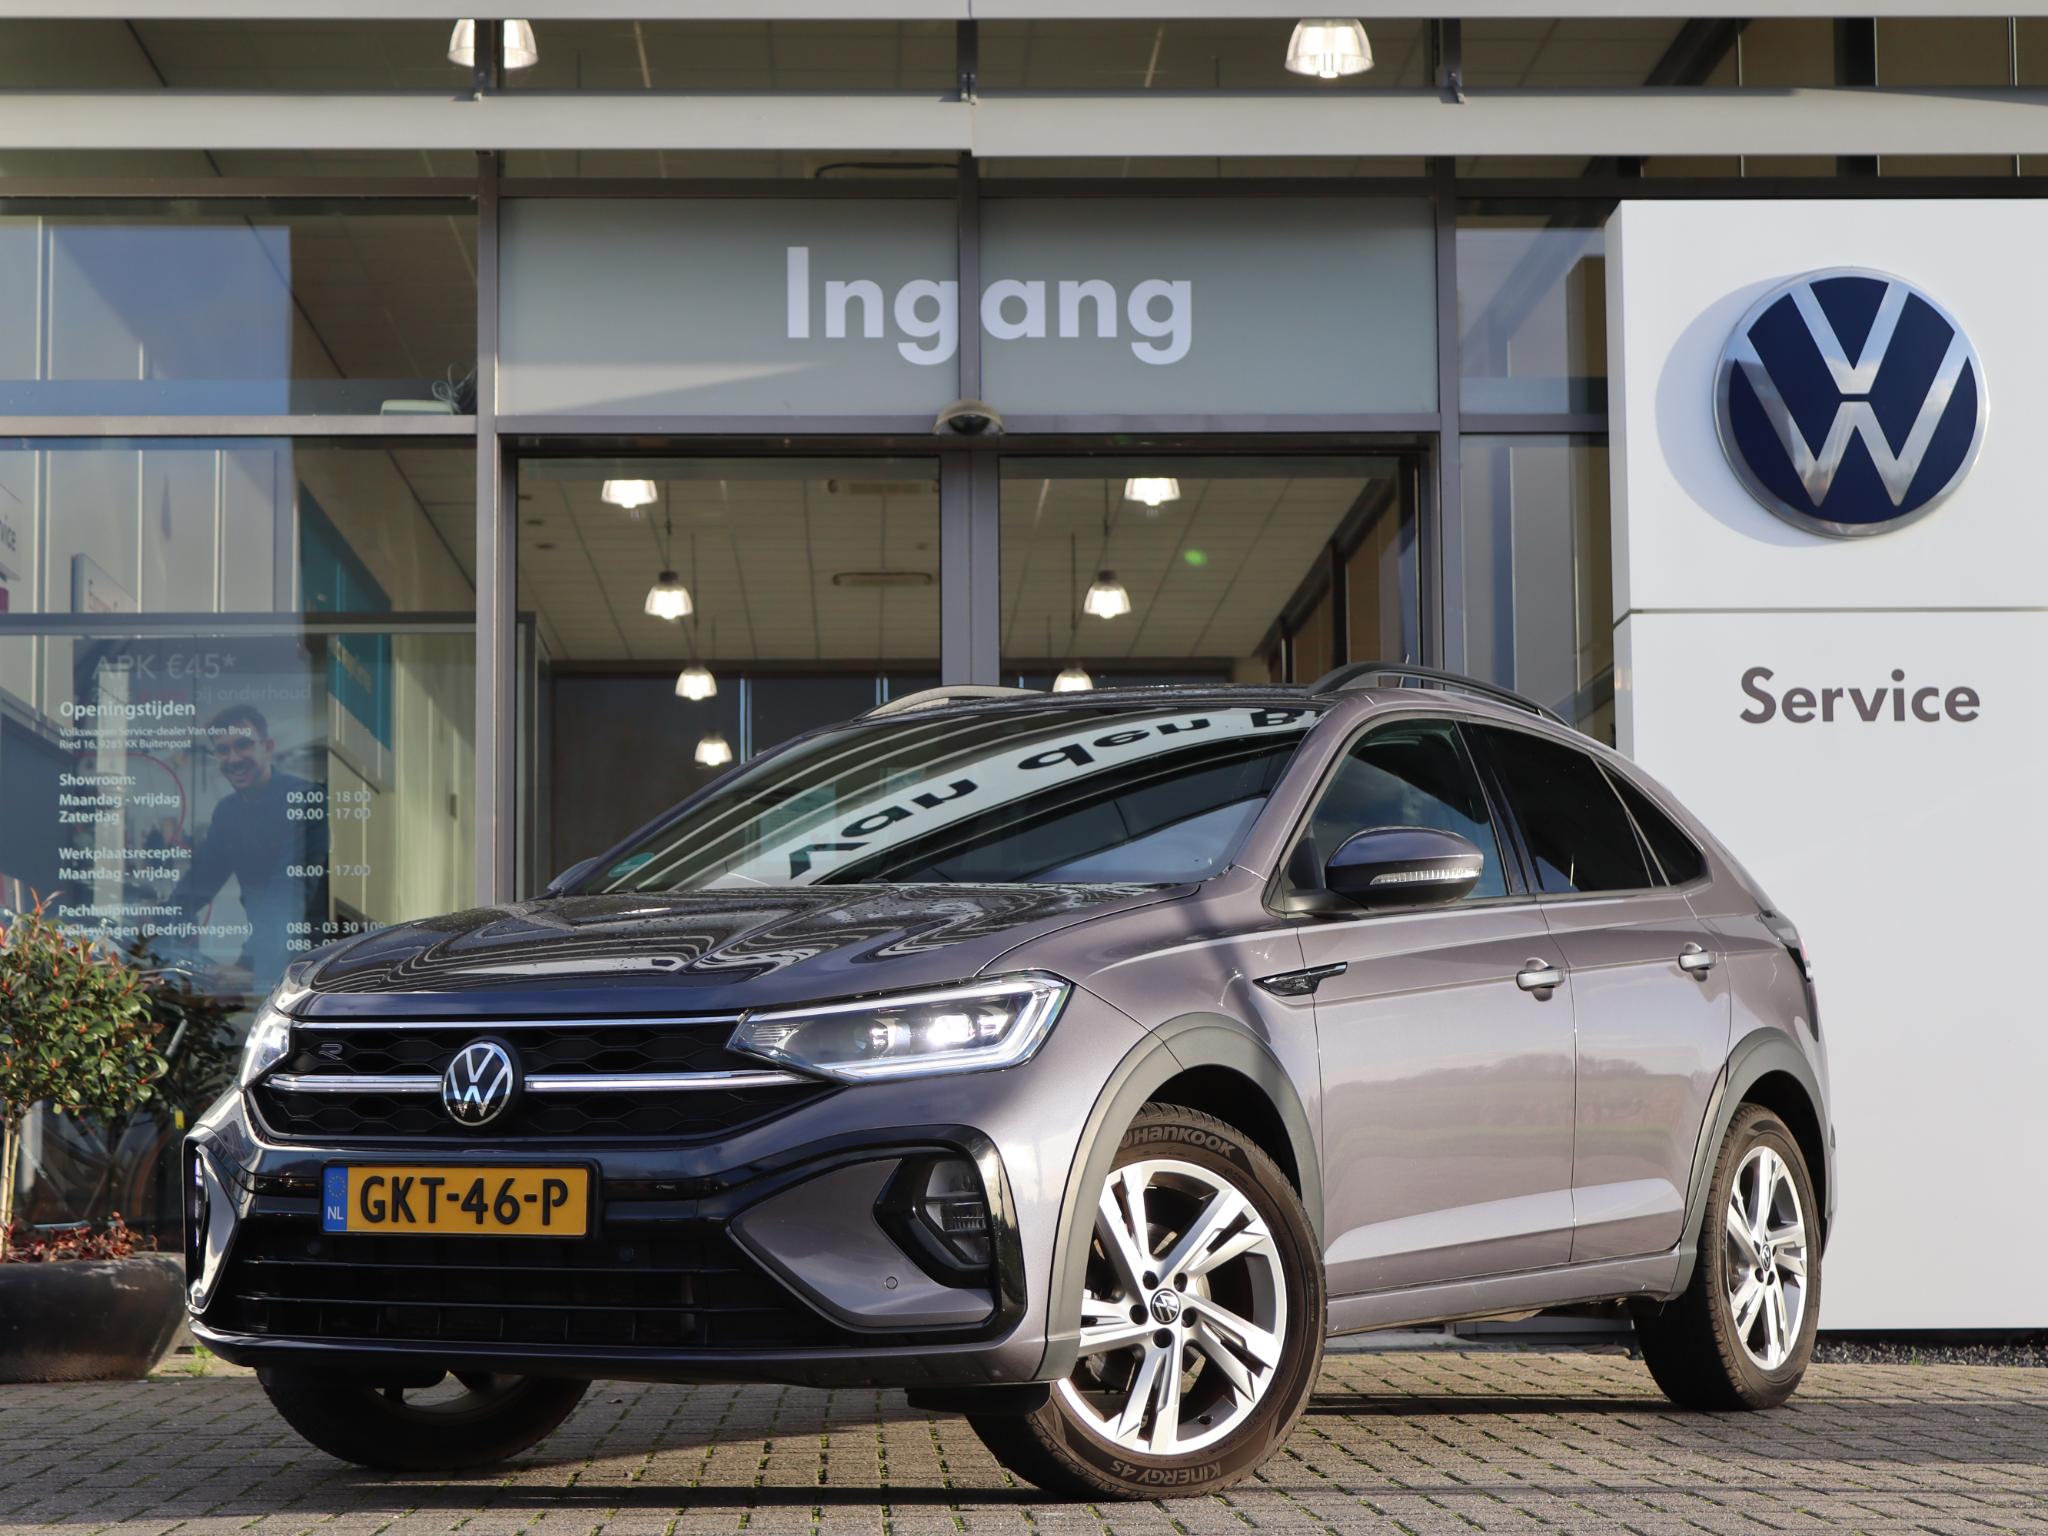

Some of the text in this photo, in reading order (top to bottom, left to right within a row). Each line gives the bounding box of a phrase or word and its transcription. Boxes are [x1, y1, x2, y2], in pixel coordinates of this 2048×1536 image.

[787, 246, 1192, 365] Ingang
[93, 654, 156, 680] APK
[1739, 666, 1981, 724] Service
[59, 701, 197, 720] Openingstijden
[117, 726, 187, 736] Service-dealer
[188, 726, 206, 736] Van
[207, 726, 226, 736] den
[228, 726, 252, 738] Brug
[59, 739, 81, 749] Ried
[139, 739, 191, 751] Buitenpost
[59, 774, 136, 787] Showroom:
[59, 793, 122, 808] Maandag
[133, 792, 181, 808] vrijdag
[286, 791, 324, 804] 09.00
[335, 791, 371, 804] 1800
[59, 811, 120, 826] Zaterdag
[286, 808, 324, 821] 09.00
[335, 808, 371, 821] 1700
[59, 846, 192, 862] Werkplaatsreceptie:
[59, 867, 122, 882] Maandag
[133, 867, 181, 883] vrijdag
[286, 865, 324, 878] 08.00
[58, 904, 182, 919] Pechhulpnummer:
[142, 922, 254, 939] (Bedrijfswagens)
[286, 922, 312, 935] 088
[322, 922, 339, 934] 03
[342, 922, 359, 933] 30
[286, 938, 312, 951] 088
[327, 1175, 568, 1226] NL GKT-46-P
